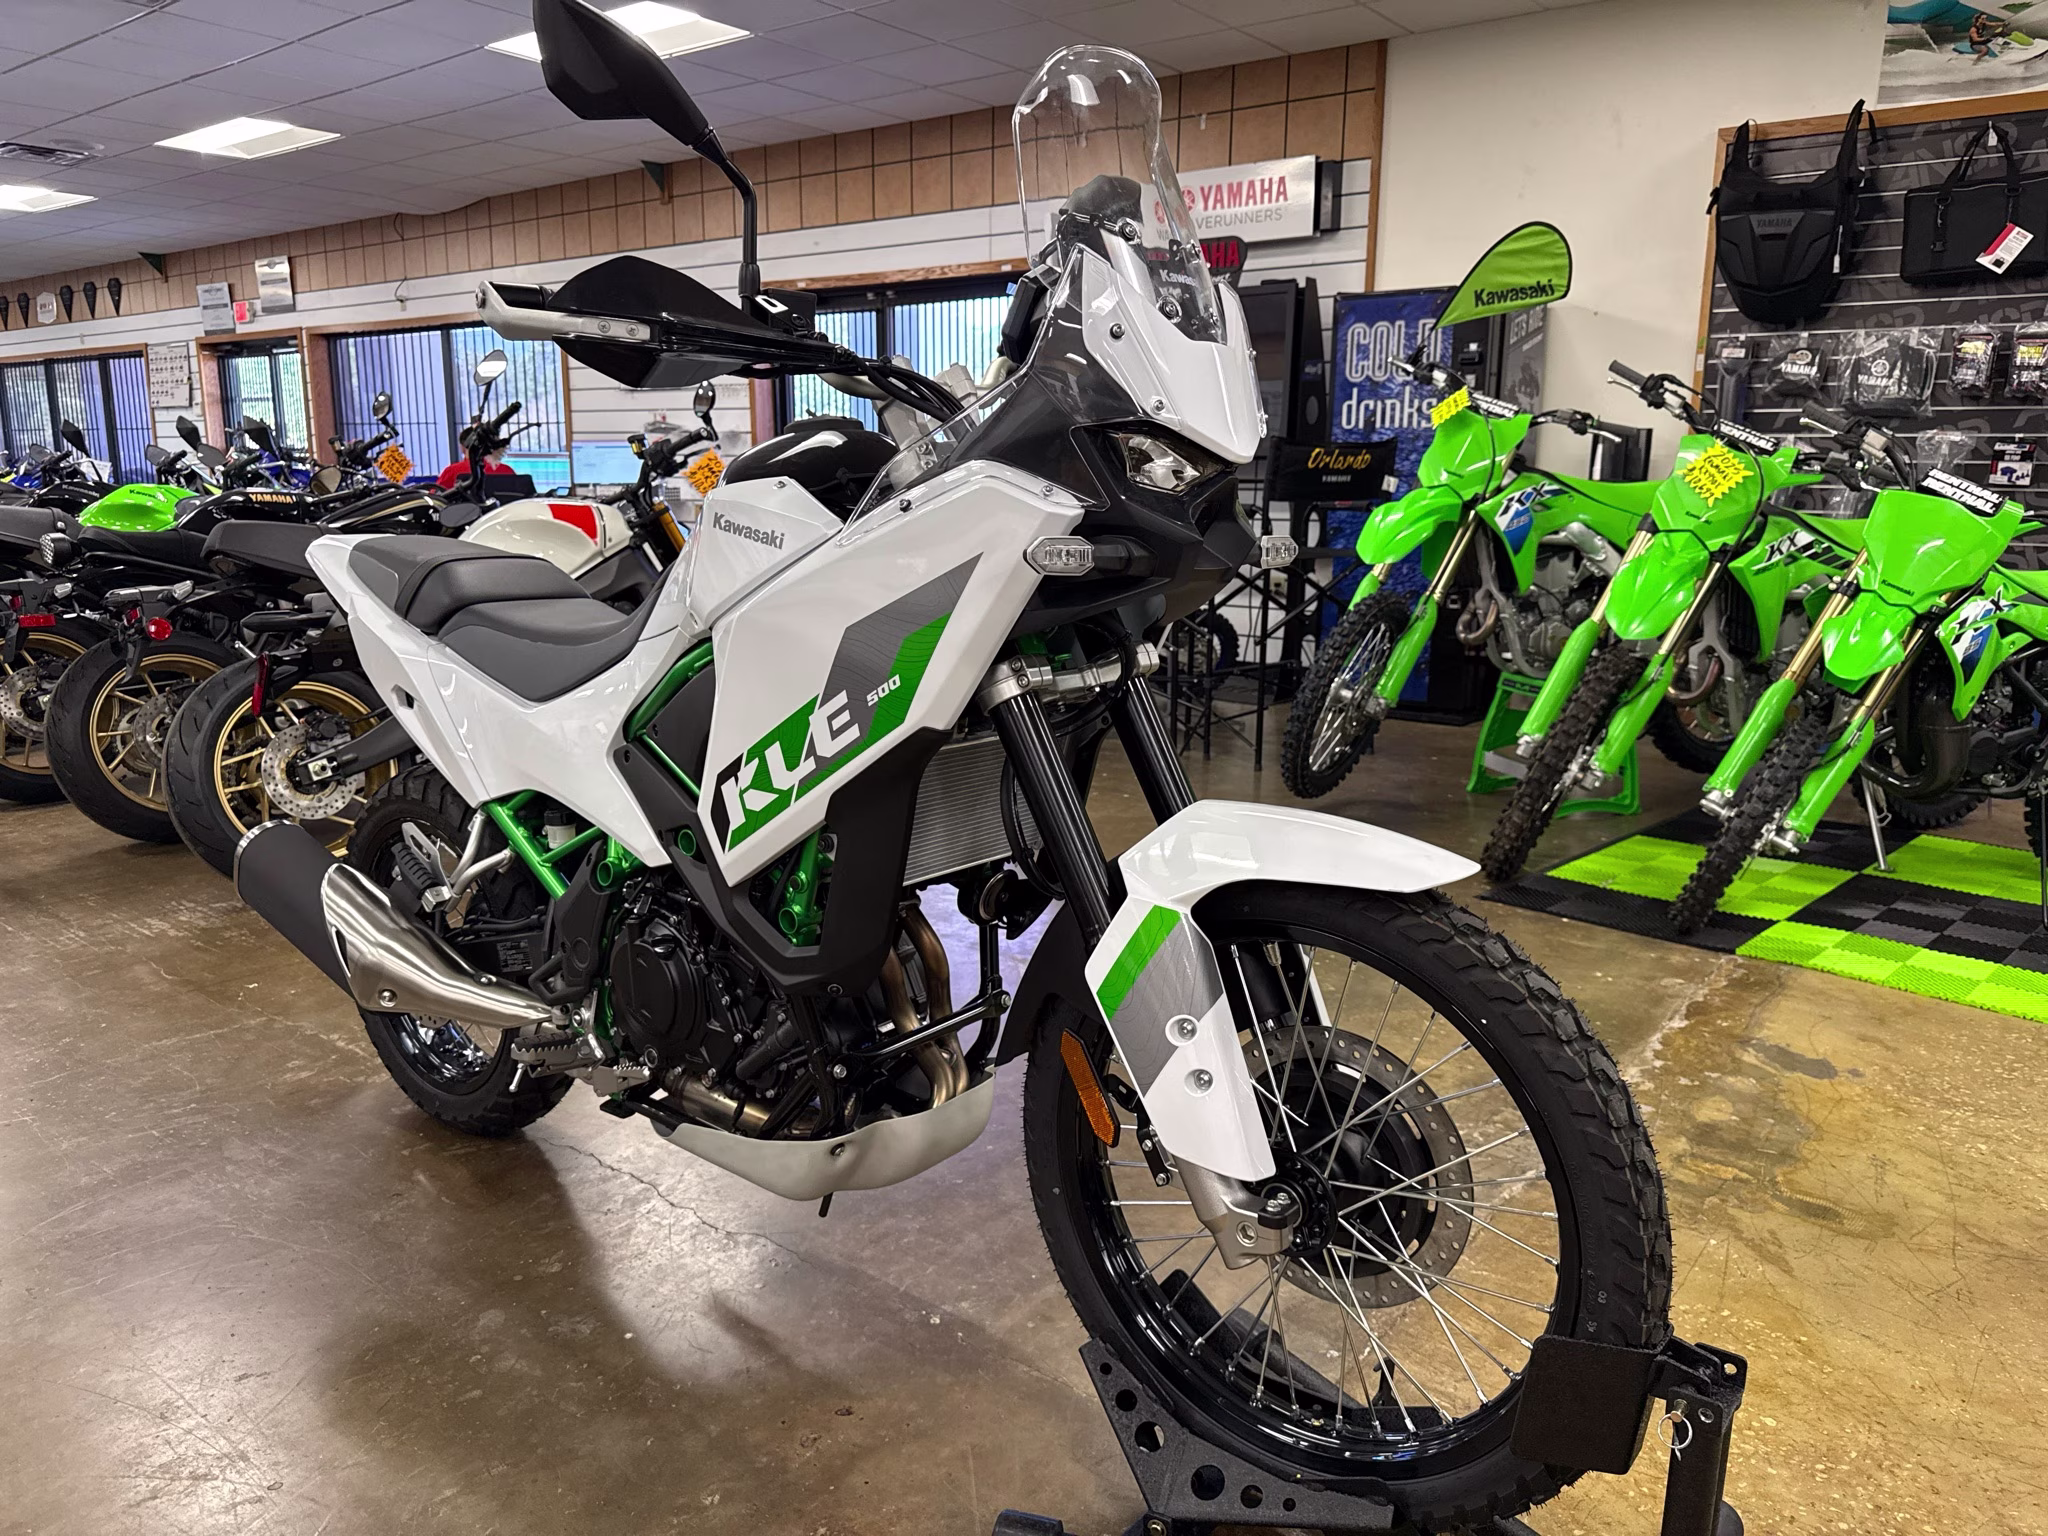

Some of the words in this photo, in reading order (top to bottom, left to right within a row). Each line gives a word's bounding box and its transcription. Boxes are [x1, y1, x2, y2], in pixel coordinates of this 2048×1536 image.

[1200, 176, 1288, 212] YAMAHA
[1196, 208, 1283, 230] VERUNNERS
[1756, 217, 1793, 229] YAMAHA
[1201, 240, 1240, 269] AHA
[1474, 279, 1555, 308] Kawasaki
[1345, 317, 1443, 382] COLD
[1780, 362, 1820, 376] YAMAHA
[1341, 387, 1436, 430] drinks
[1714, 422, 1776, 451] RENTHAL
[1307, 447, 1371, 470] Orlando
[249, 493, 294, 504] YAMAHA
[1921, 476, 1996, 514] RENTHAL
[1928, 468, 2002, 504] RENTHAL
[712, 512, 785, 549] Kawasaki
[1765, 530, 1799, 564] KX
[866, 674, 901, 706] 500
[721, 690, 860, 832] KLE
